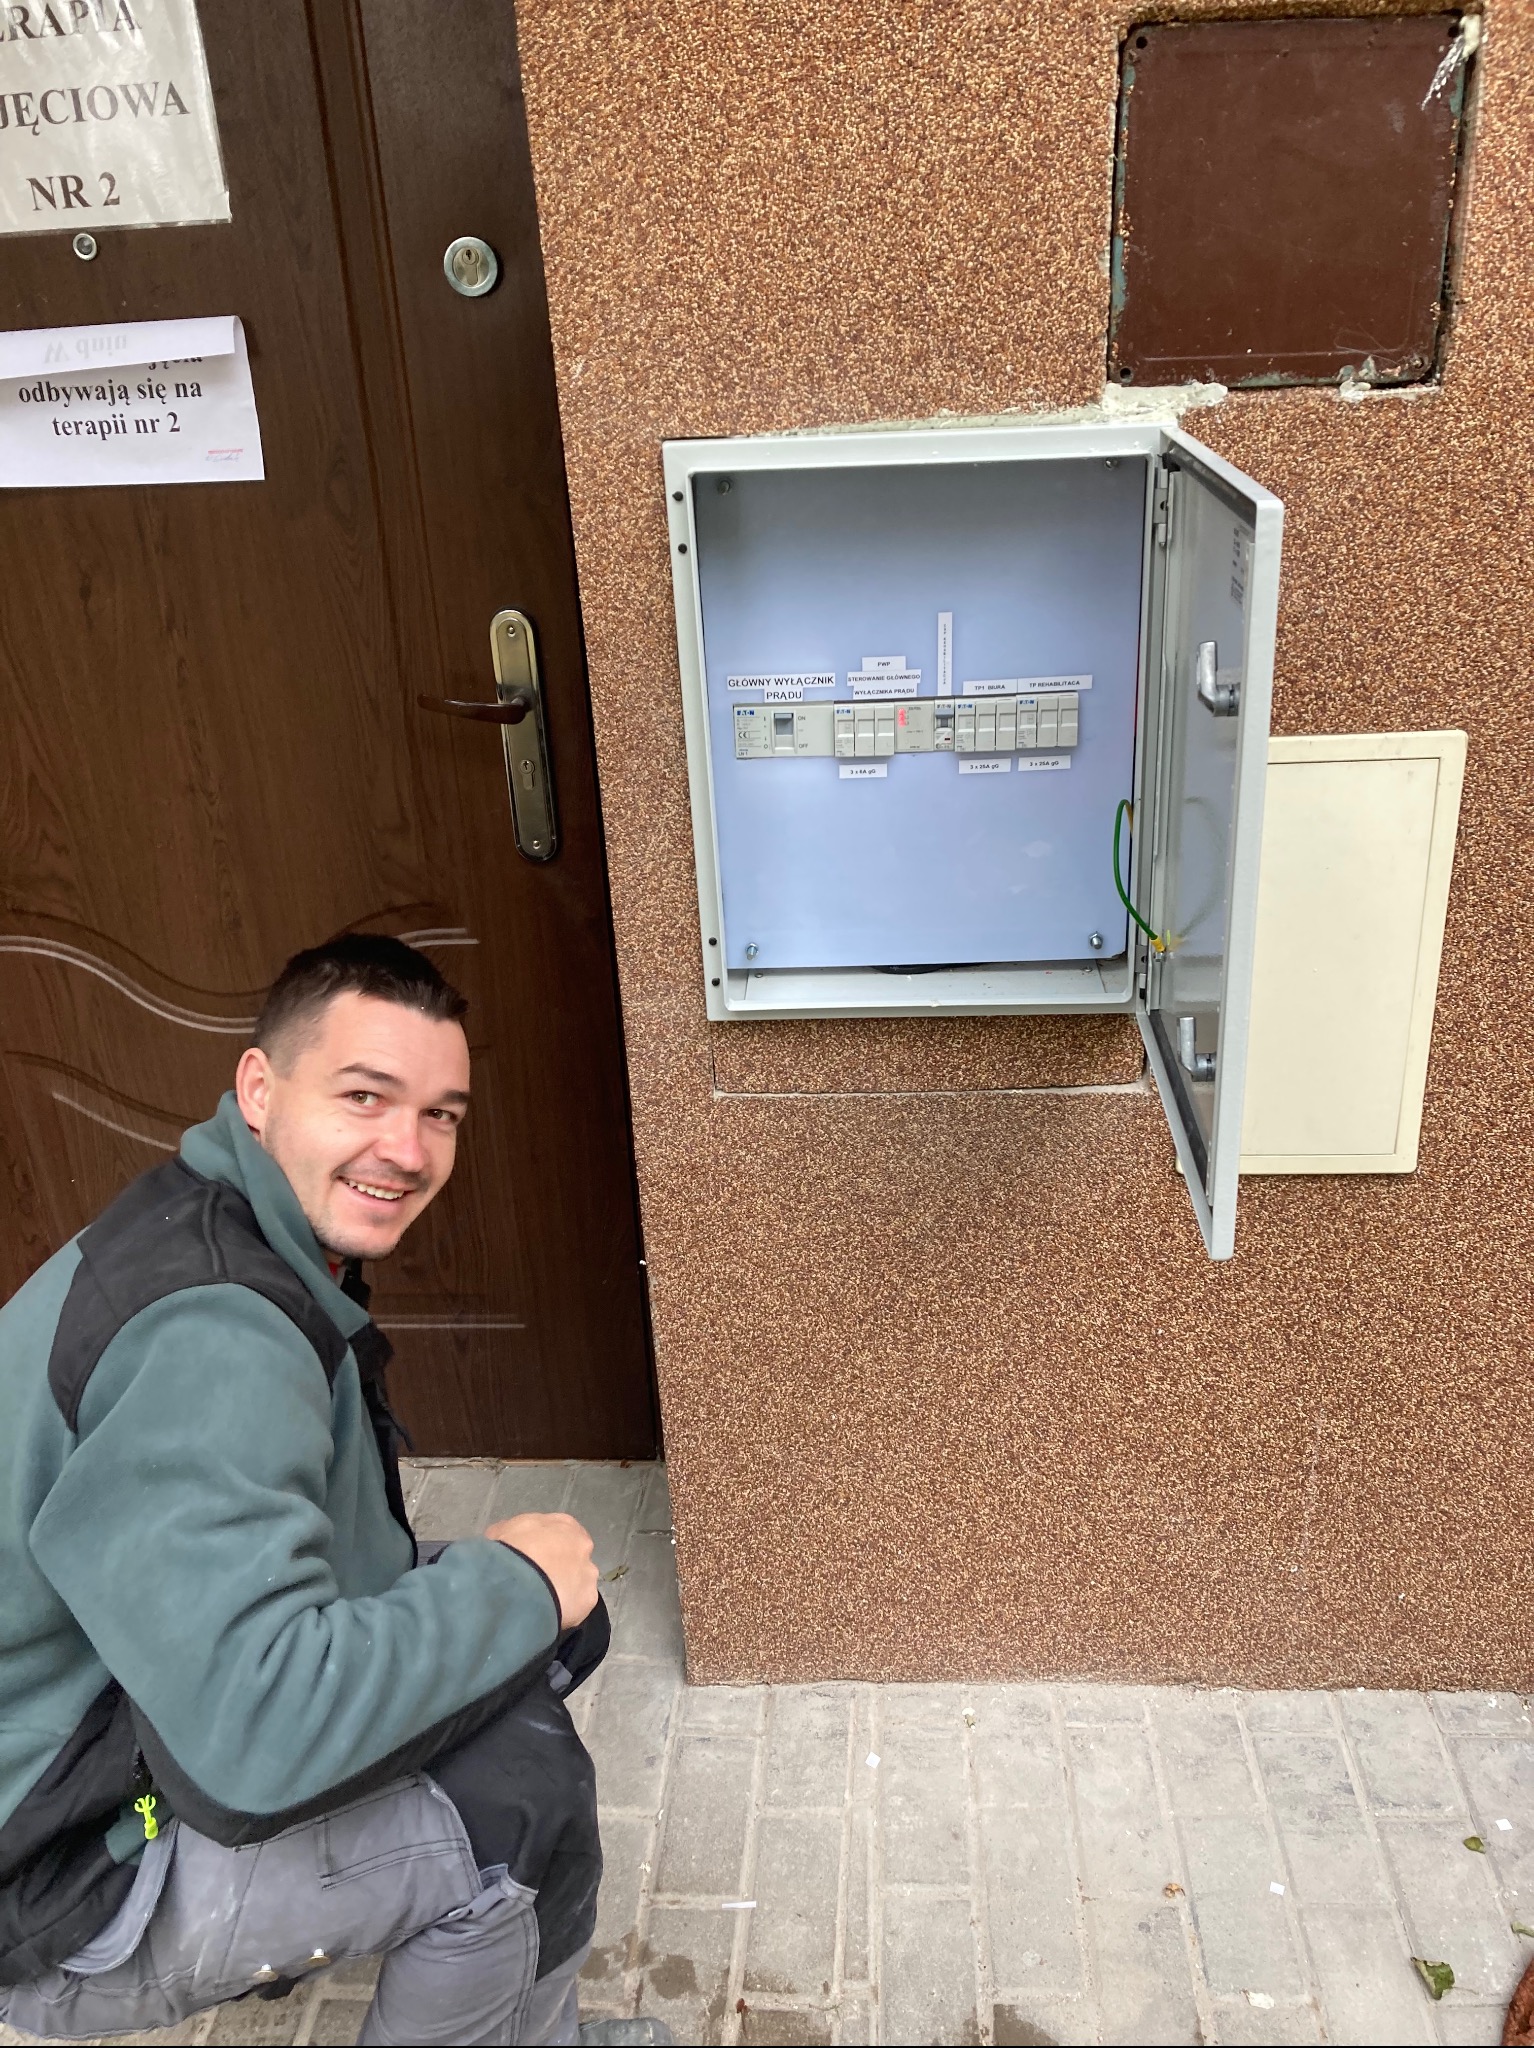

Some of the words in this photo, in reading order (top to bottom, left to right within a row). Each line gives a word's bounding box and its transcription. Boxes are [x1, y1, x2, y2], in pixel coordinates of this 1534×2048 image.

[0, 0, 142, 42] RAPIA
[26, 175, 92, 211] NR
[98, 171, 120, 206] 2
[18, 379, 130, 407] odbywają
[137, 378, 167, 404] się
[175, 381, 202, 398] na
[52, 413, 128, 440] terapii
[135, 417, 160, 434] nr
[167, 411, 181, 433] 2
[728, 677, 771, 688] GŁÓWNY
[775, 675, 834, 687] WYŁĄCZNIK
[886, 673, 920, 681] GŁÓWNEGO
[766, 690, 802, 701] PRĄDU
